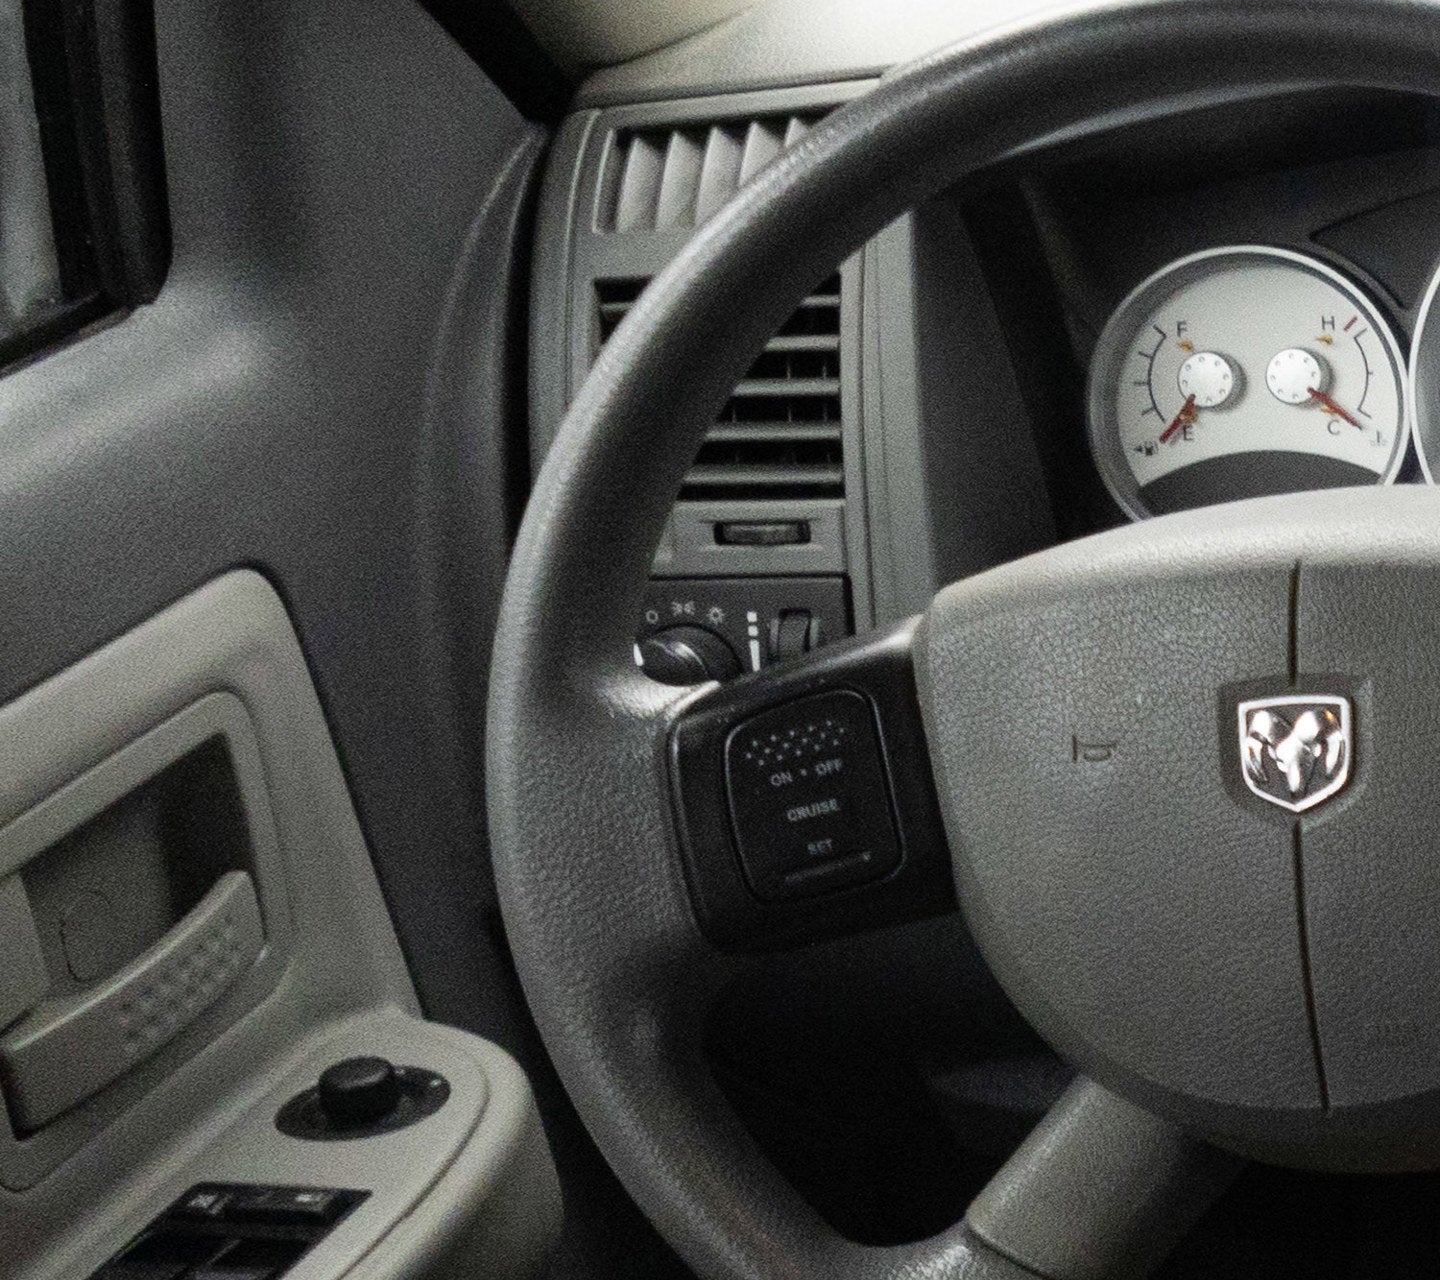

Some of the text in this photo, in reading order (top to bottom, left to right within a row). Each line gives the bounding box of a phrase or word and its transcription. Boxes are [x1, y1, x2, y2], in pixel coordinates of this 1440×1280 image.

[1176, 321, 1189, 337] F
[1320, 315, 1336, 331] H
[1183, 424, 1194, 442] E
[1326, 420, 1340, 437] C
[770, 772, 793, 787] ON
[786, 799, 840, 821] CRUISE
